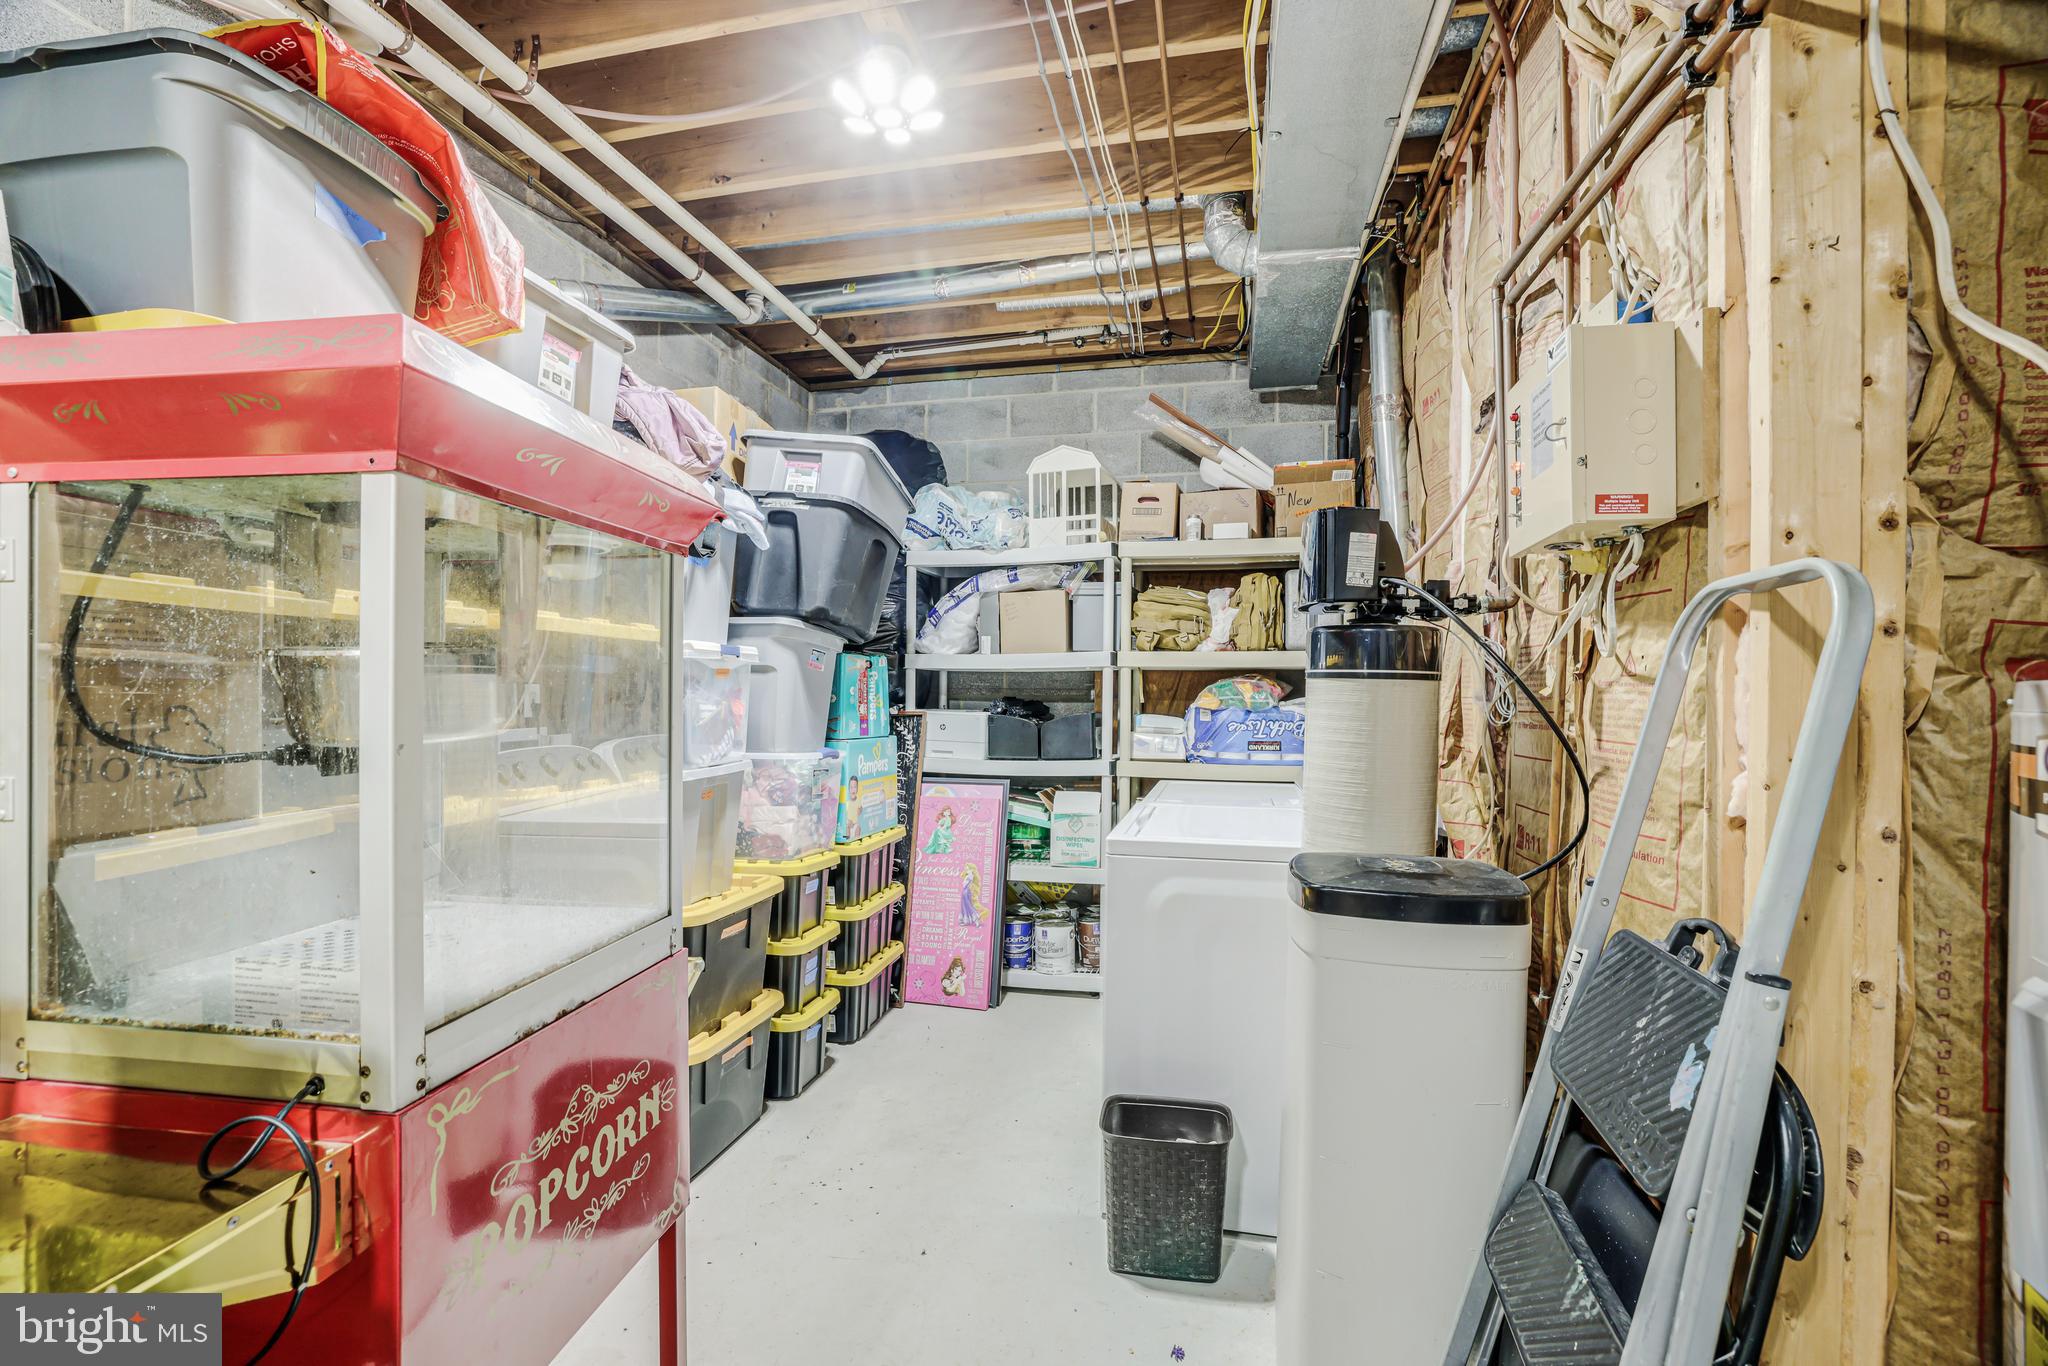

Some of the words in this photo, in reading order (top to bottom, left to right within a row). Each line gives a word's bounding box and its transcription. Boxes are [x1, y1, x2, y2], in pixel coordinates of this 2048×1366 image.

[1288, 490, 1313, 507] New
[1267, 718, 1305, 738] Bath
[1248, 743, 1281, 751] KIRKLAND
[858, 754, 888, 776] Pampers
[1937, 927, 1951, 1000] 08:37
[471, 1081, 662, 1288] POPCORN
[1937, 1230, 1951, 1245] D
